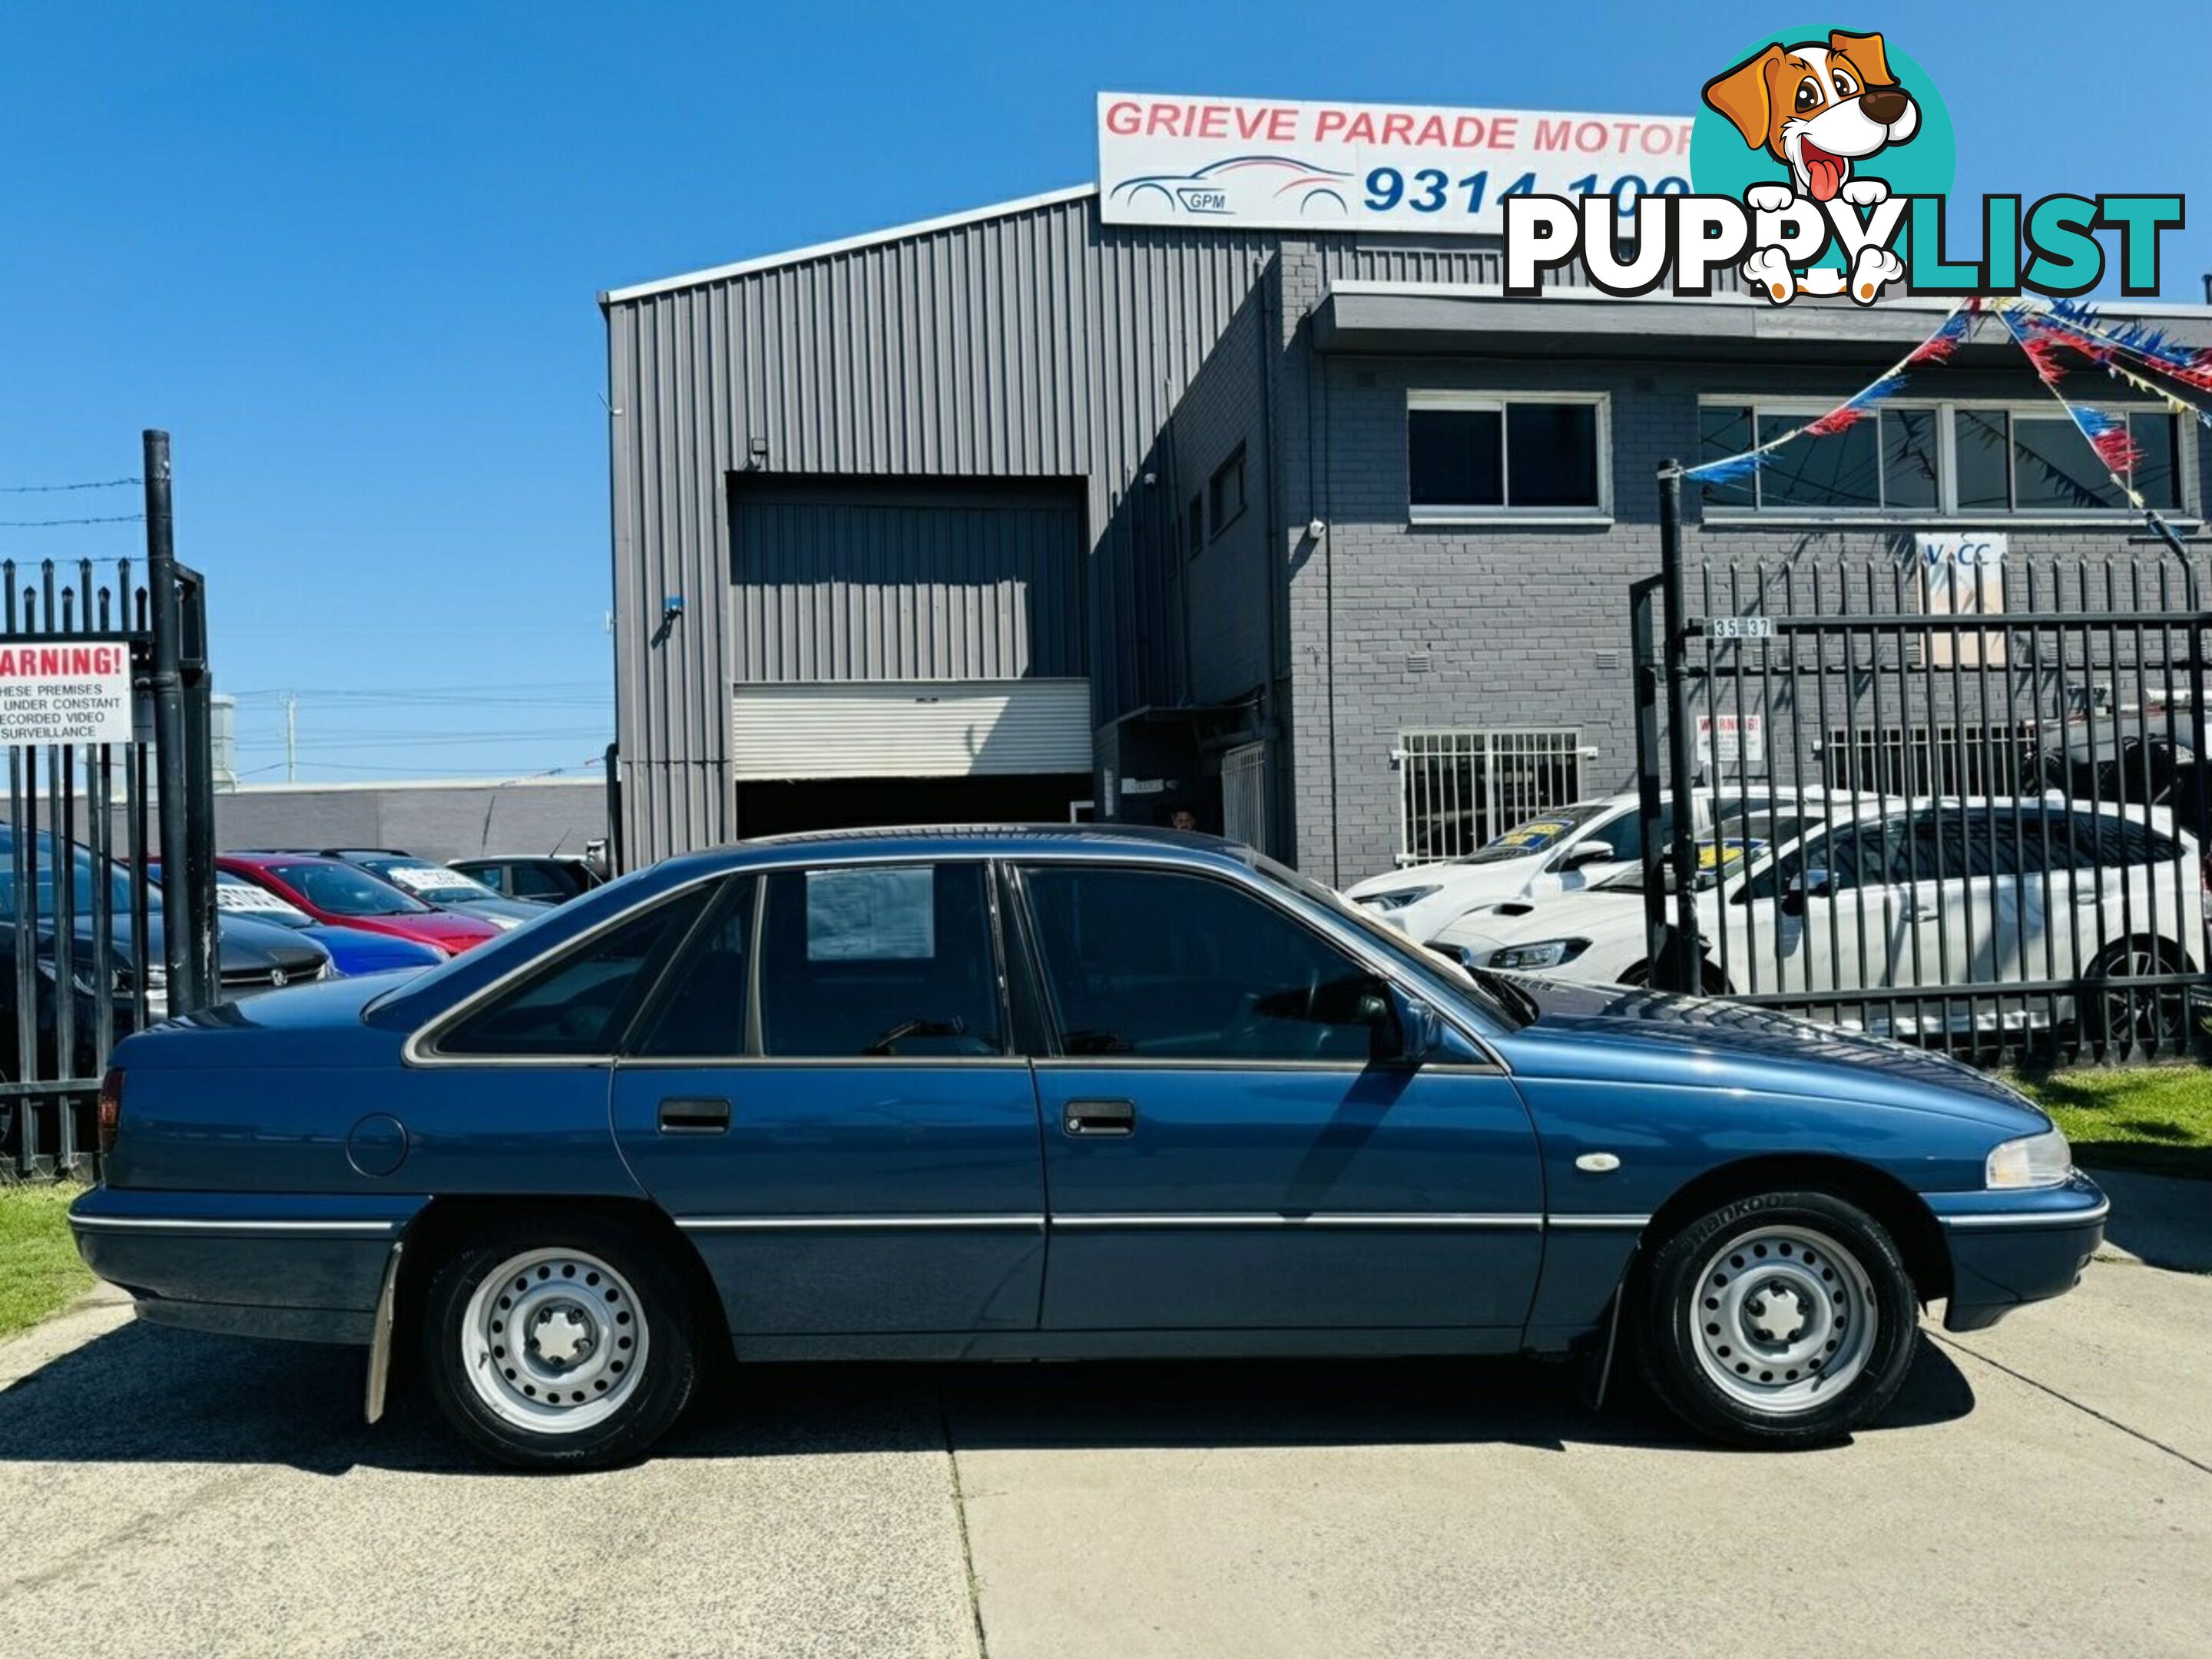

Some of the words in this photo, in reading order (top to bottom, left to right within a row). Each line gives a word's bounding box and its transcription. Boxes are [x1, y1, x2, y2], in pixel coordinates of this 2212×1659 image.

[1106, 101, 1300, 141] GRIEVE
[1314, 110, 1518, 150] PARADE
[1190, 193, 1226, 210] GPM
[1926, 543, 1991, 566] VCC
[38, 684, 103, 696] PREMISES
[4, 699, 48, 711] UNDER
[53, 697, 121, 710] CONSTANT
[65, 711, 105, 723] VIDEO
[1, 725, 97, 740] SURVEILLANCE
